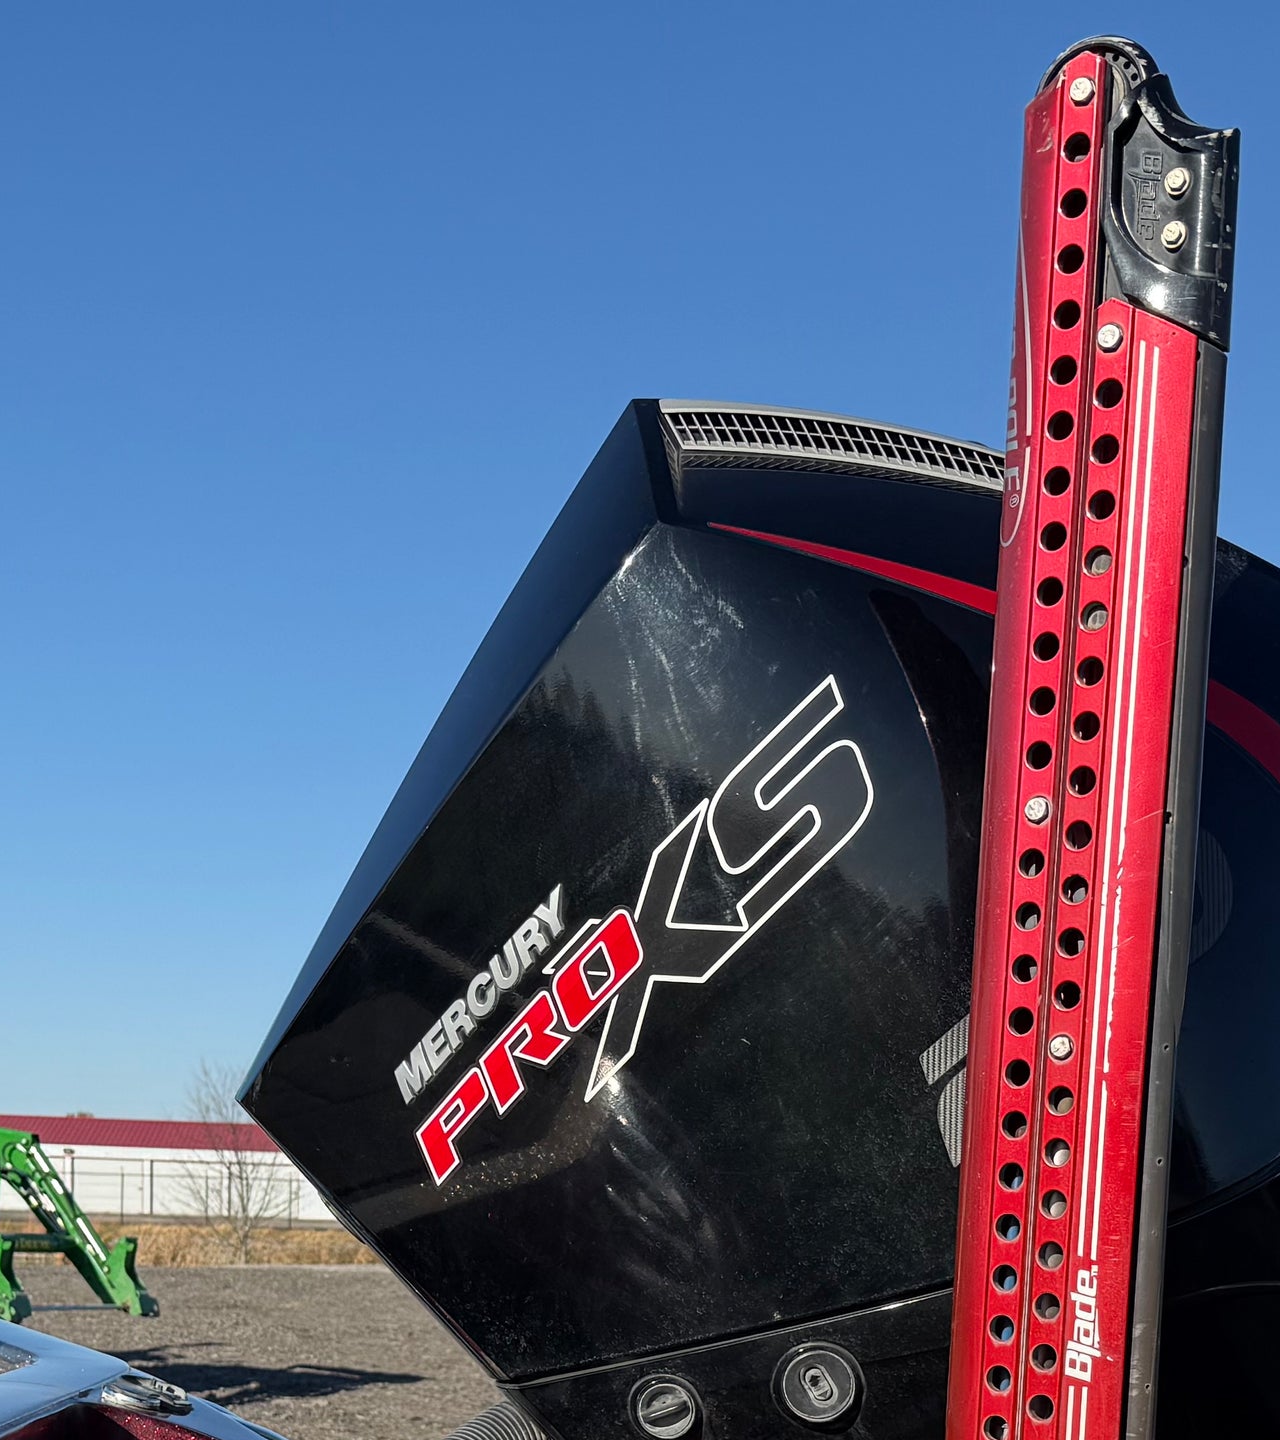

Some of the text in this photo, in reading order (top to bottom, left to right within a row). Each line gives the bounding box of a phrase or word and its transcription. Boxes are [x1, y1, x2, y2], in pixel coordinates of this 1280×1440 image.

[1127, 150, 1164, 241] Blade
[394, 884, 566, 1105] MERCURY
[416, 674, 875, 1187] PRO XS
[1064, 1268, 1102, 1382] Blade
